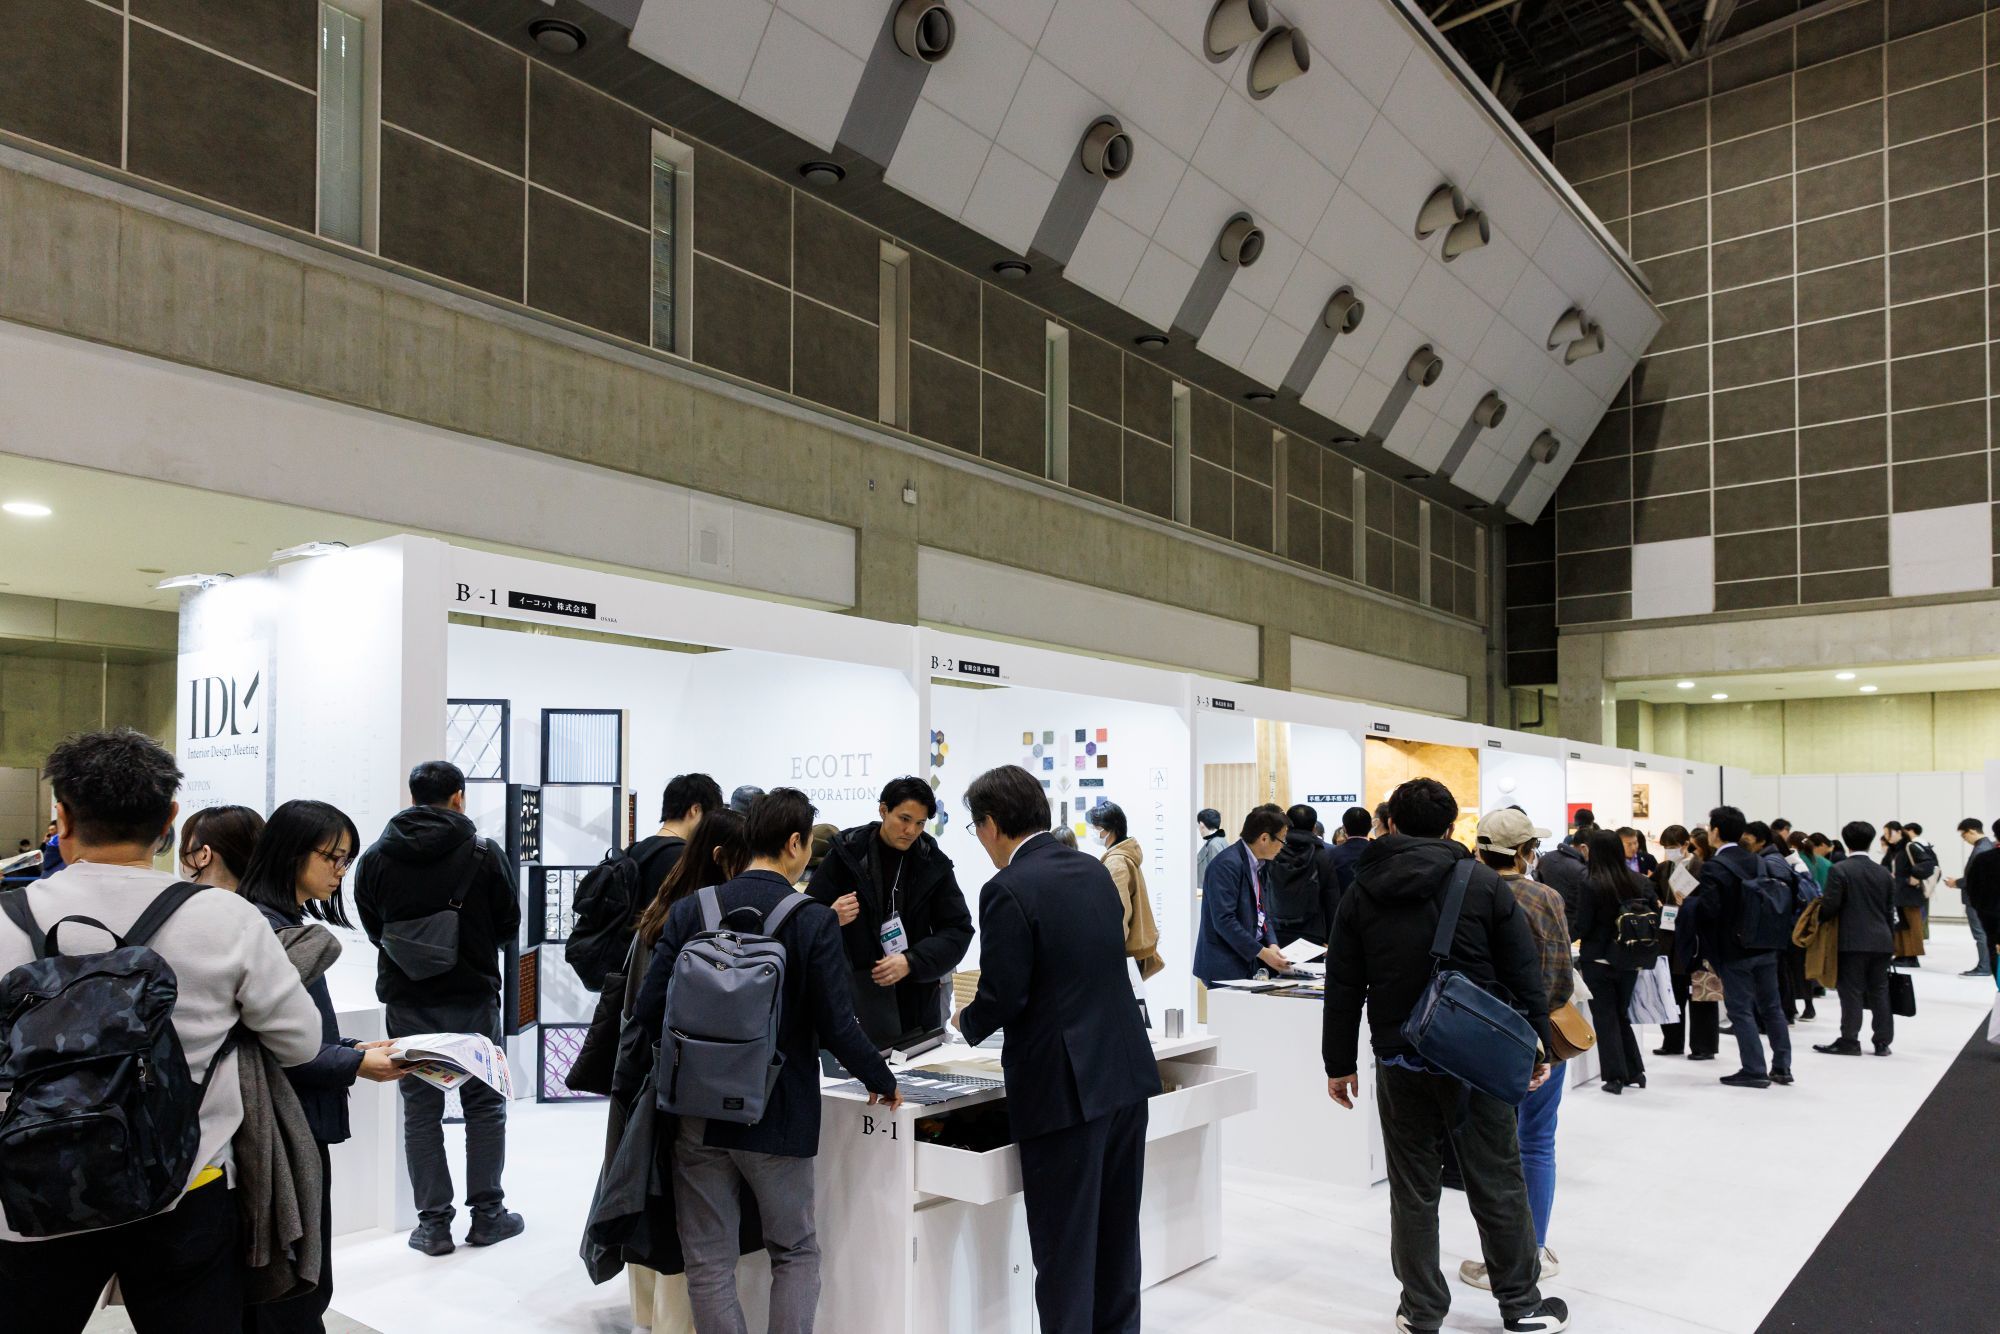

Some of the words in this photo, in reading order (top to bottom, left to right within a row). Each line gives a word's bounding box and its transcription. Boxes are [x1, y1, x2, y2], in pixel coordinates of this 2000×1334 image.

[520, 597, 552, 609] イーコット
[557, 601, 588, 615] 株式会社
[187, 747, 210, 760] Interior
[211, 745, 232, 760] Design
[232, 743, 259, 759] Meeting
[790, 753, 872, 780] ECOTT
